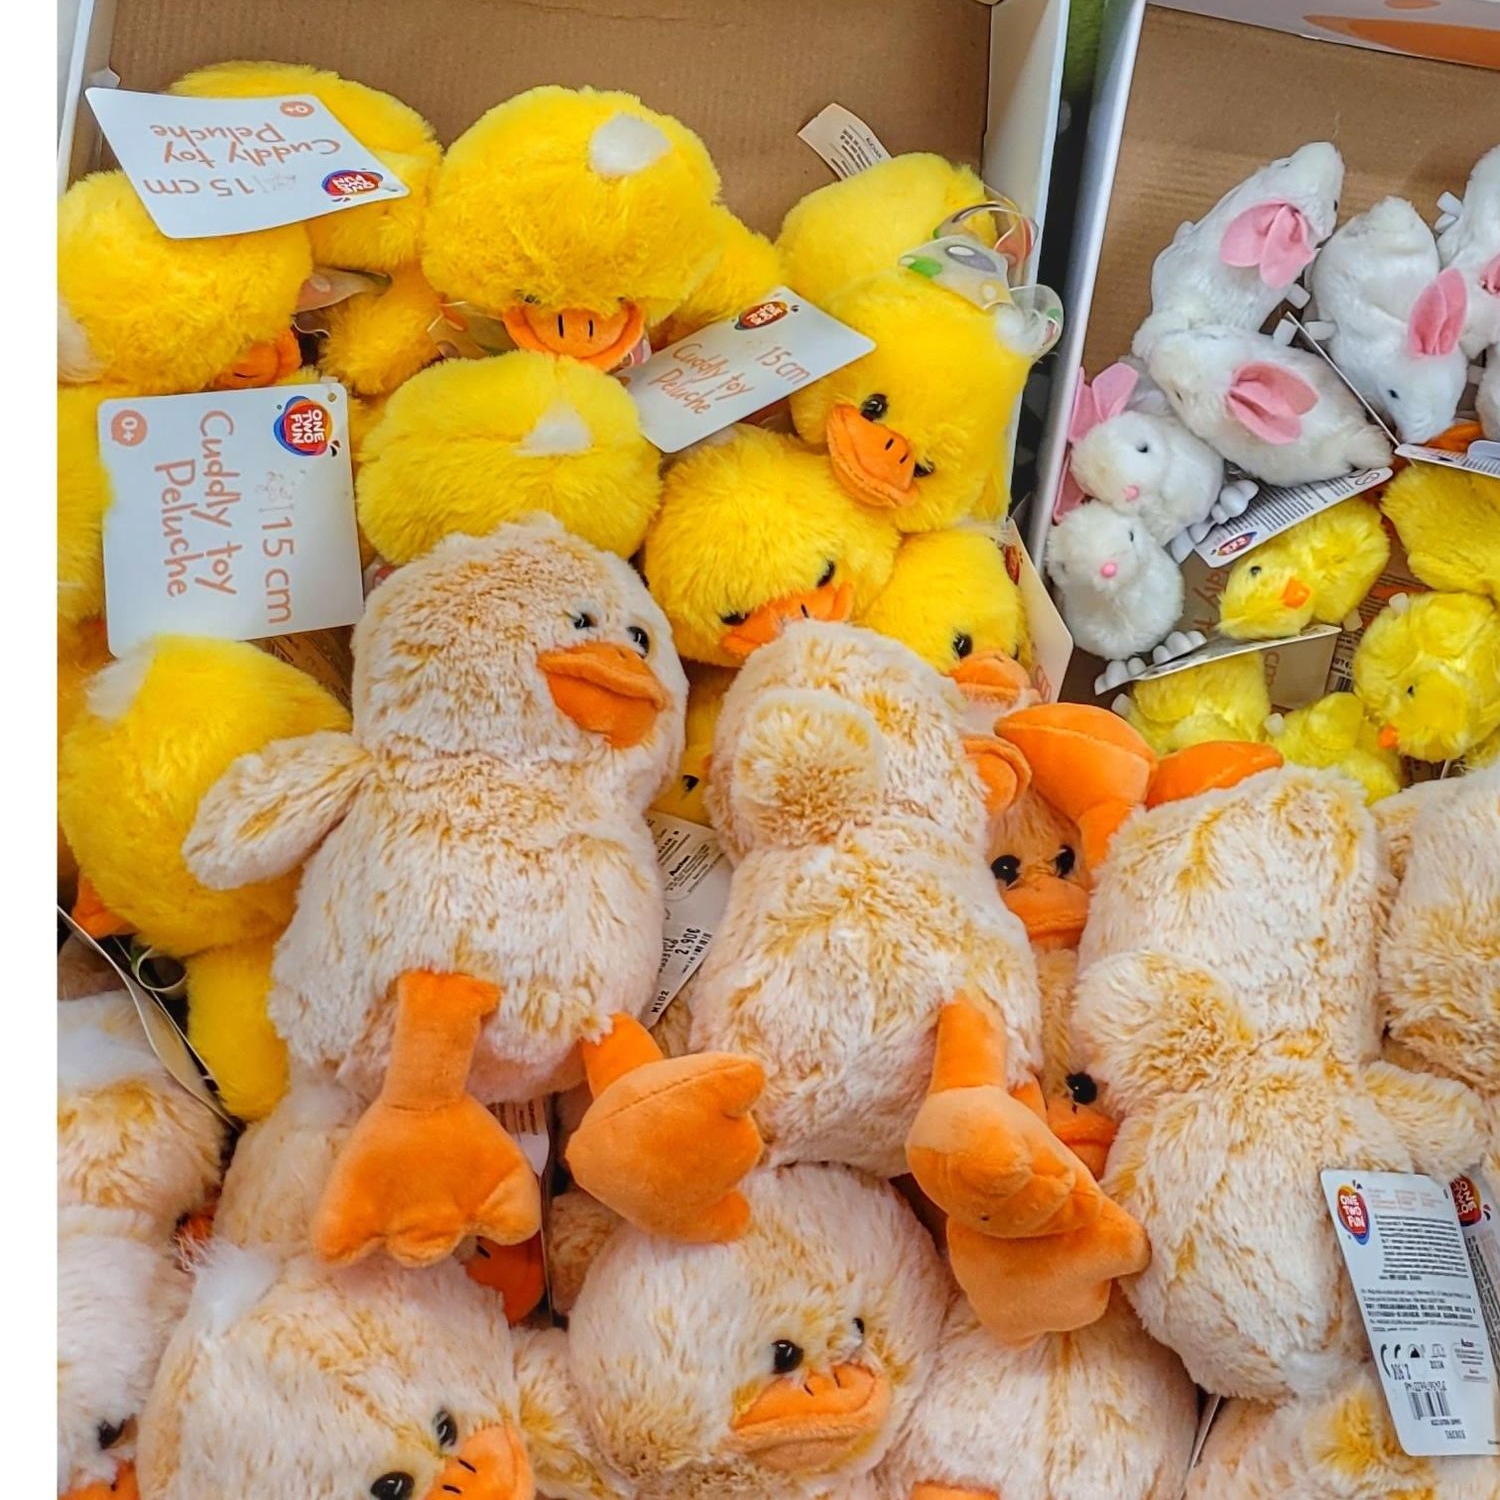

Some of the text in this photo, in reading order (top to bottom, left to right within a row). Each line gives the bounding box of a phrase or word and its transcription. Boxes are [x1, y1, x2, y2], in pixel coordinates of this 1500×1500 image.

[150, 123, 286, 146] Peluche
[164, 139, 341, 168] Cuddly toy
[143, 178, 255, 197] 15 cm
[672, 343, 755, 401] Cuddly toy
[755, 346, 812, 385] 15 cm
[648, 368, 712, 414] Peluche
[121, 416, 138, 443] 0+
[291, 413, 304, 445] FUN
[302, 410, 314, 444] TWO
[311, 409, 325, 443] ONE
[190, 410, 243, 595] Cuddly toy
[154, 458, 205, 598] Peluche
[261, 516, 295, 624] 15 cm
